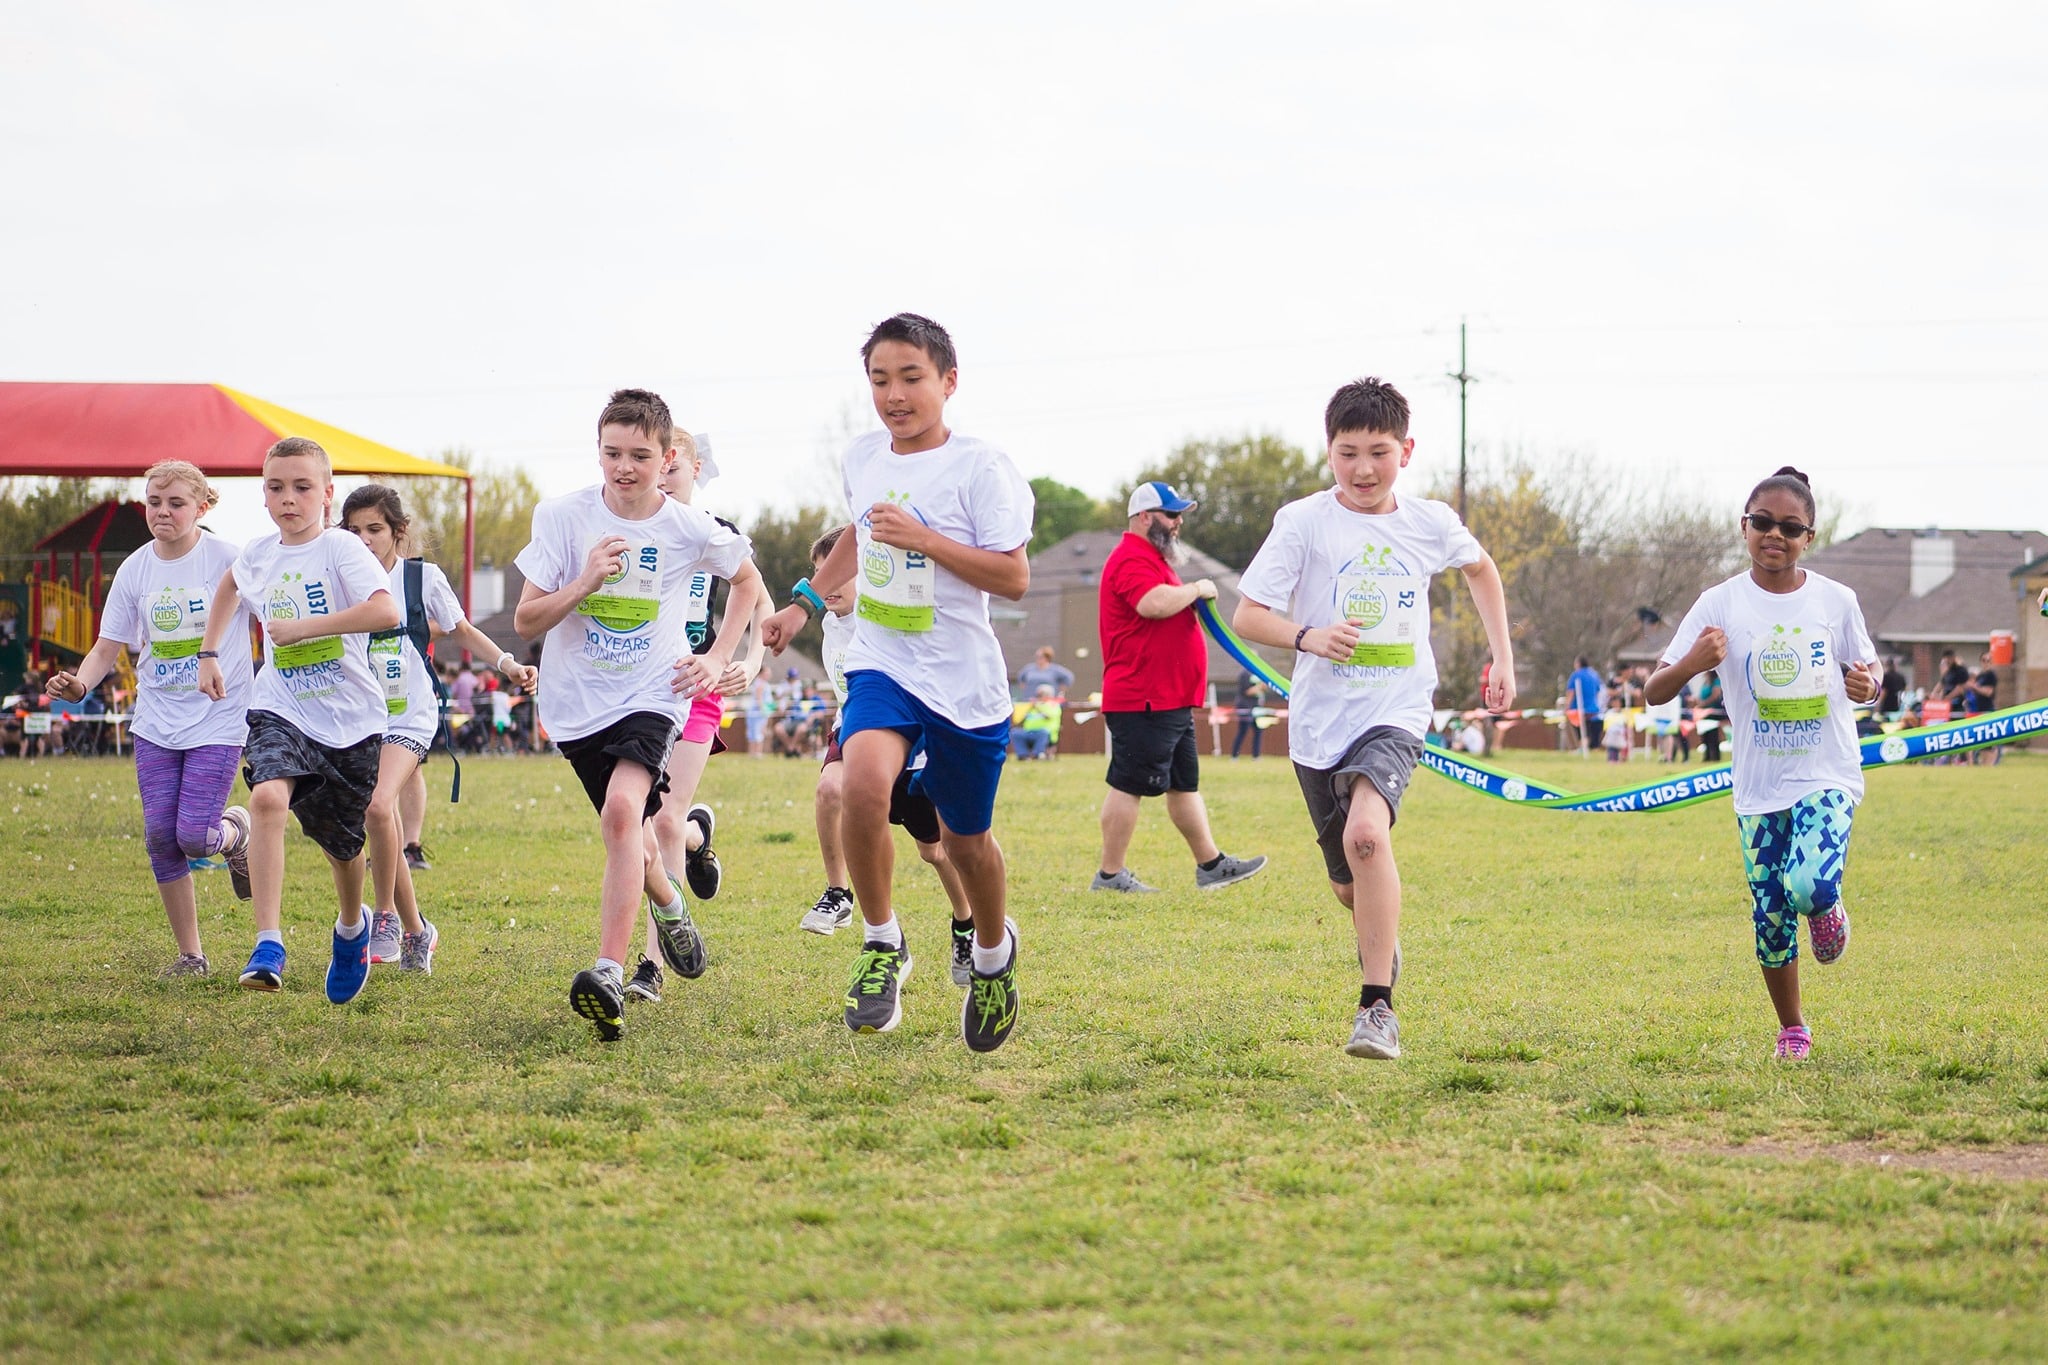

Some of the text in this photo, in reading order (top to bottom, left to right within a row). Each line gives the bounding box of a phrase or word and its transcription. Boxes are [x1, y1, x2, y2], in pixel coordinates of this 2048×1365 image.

[639, 547, 658, 572] 887
[866, 555, 889, 573] KIDS
[189, 598, 204, 613] 11
[305, 582, 328, 615] 1037
[1348, 600, 1381, 613] KIDS
[1399, 591, 1414, 608] 52
[155, 610, 178, 620] KIDS
[272, 608, 294, 619] KIDS
[585, 629, 650, 650] 10 YEARS
[584, 642, 649, 663] RUNNING
[1811, 641, 1825, 667] 842
[155, 659, 199, 675] 10 YEAR
[292, 659, 341, 676] YEARS
[387, 660, 400, 679] 665
[1763, 660, 1795, 671] KIDS
[1752, 719, 1821, 734] 10 YEARS
[1924, 709, 2048, 752] HEALTHY KIDS
[1753, 732, 1821, 748] RUNNING
[1419, 752, 1488, 789] HEALTH
[1640, 780, 1690, 807] KIDS
